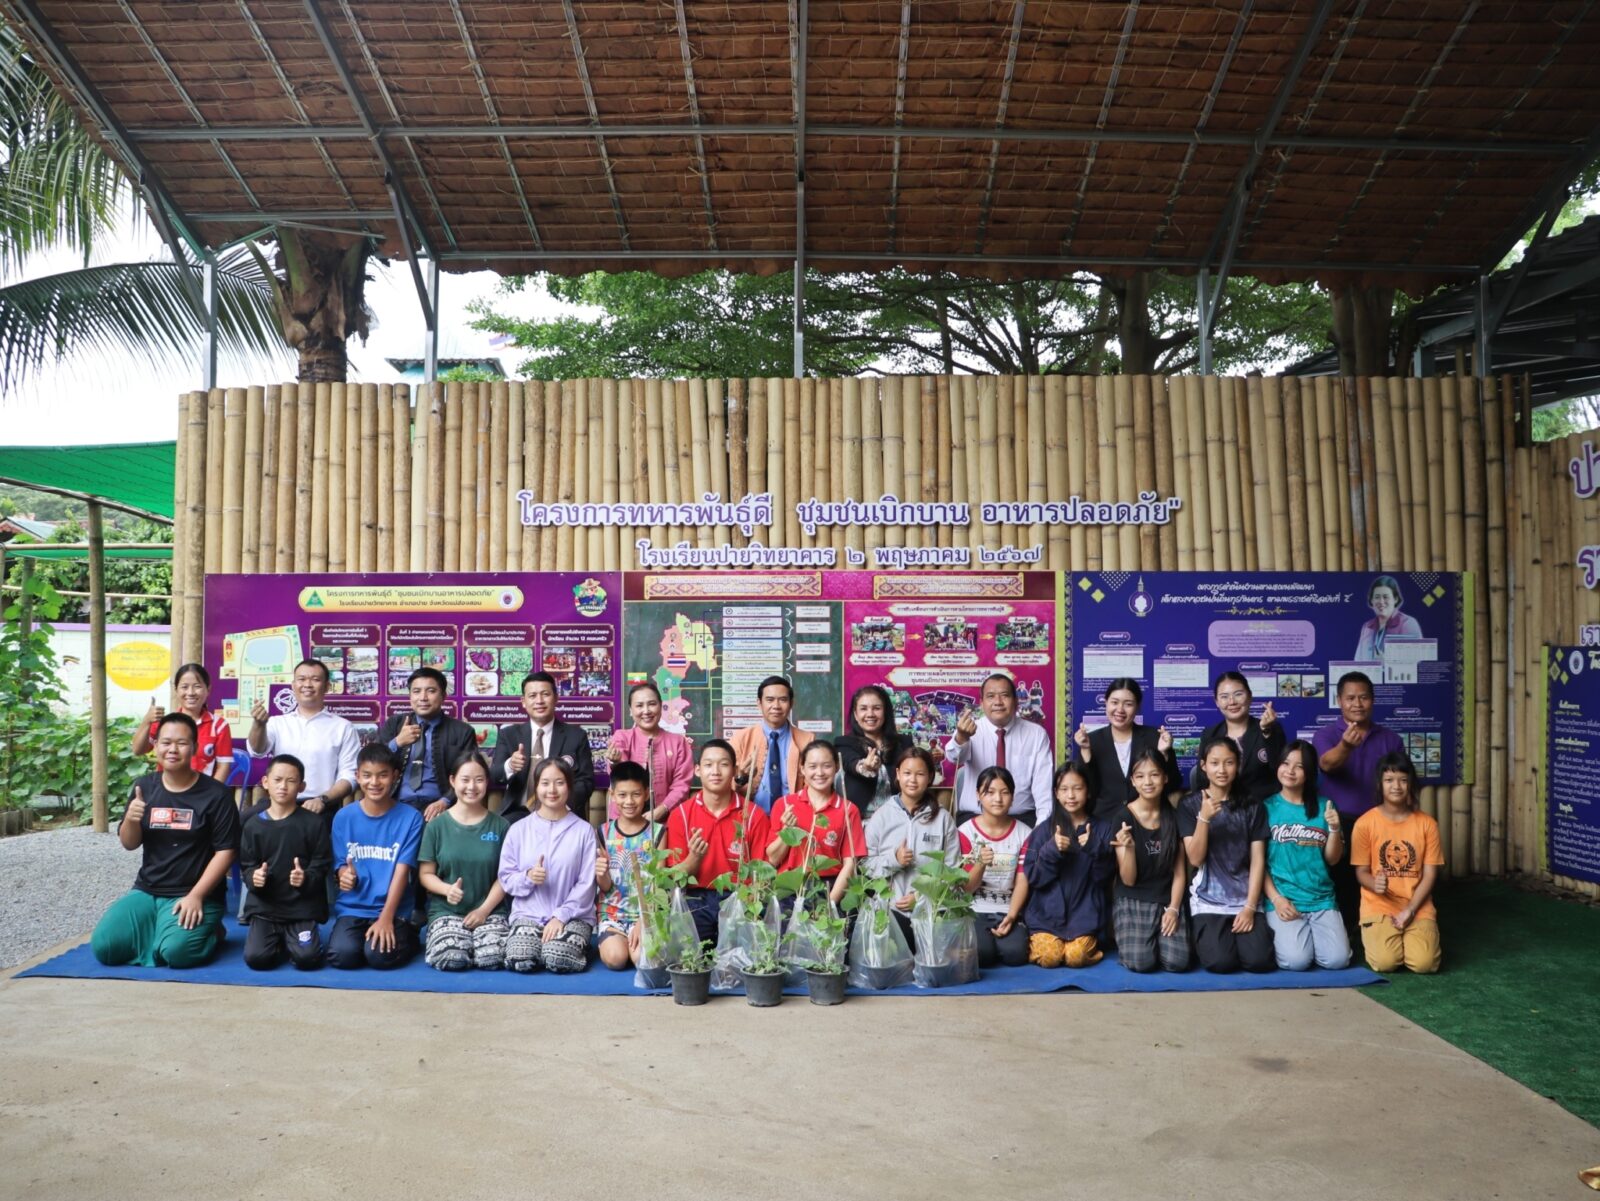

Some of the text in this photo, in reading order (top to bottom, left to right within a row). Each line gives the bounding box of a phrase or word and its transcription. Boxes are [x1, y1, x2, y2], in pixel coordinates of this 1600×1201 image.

[517, 490, 772, 536] โครงการทหารพันธุ์ดี
[797, 494, 969, 535] ชุมชนเบิกบาน
[637, 539, 1042, 569] โรงเรียนปายวิทยาคาร ๒ พฤษภาคม ๒๕๖๗
